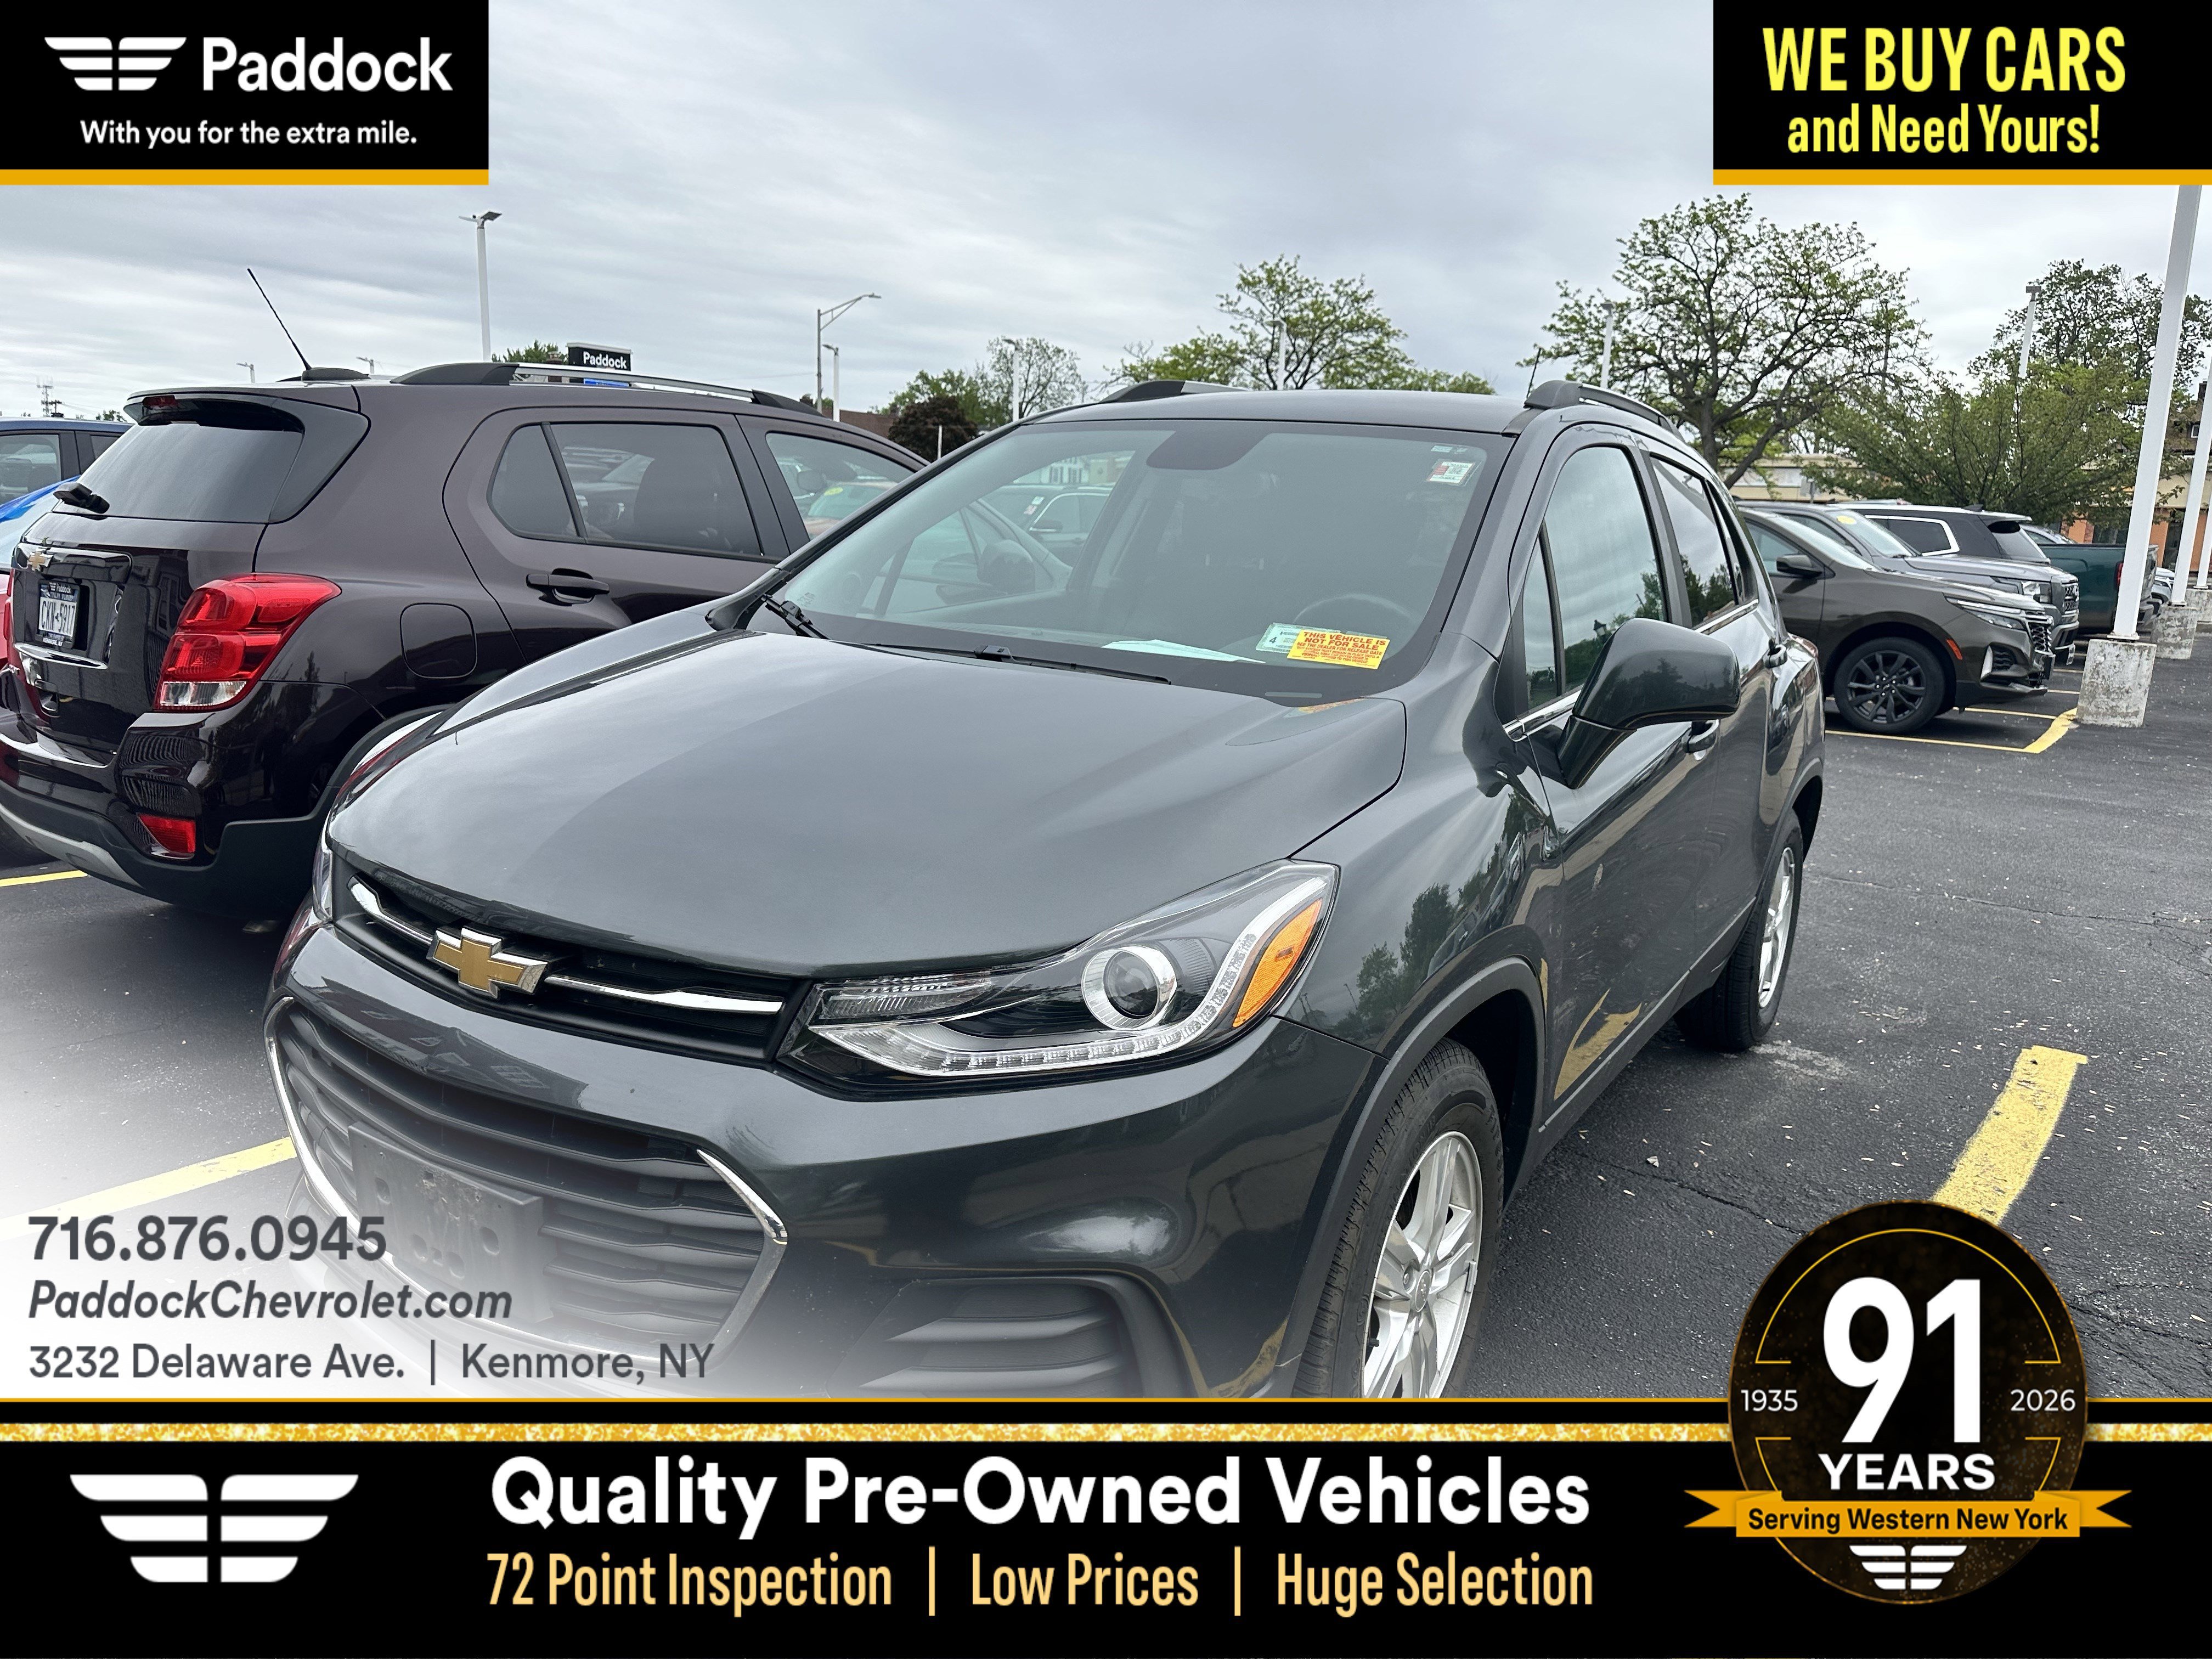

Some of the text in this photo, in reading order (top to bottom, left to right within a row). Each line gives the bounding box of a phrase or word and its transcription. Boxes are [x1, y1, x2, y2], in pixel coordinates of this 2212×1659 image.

[583, 351, 627, 369] Paddock
[1330, 634, 1373, 644] VEHICLE
[1352, 642, 1379, 651] SALE
